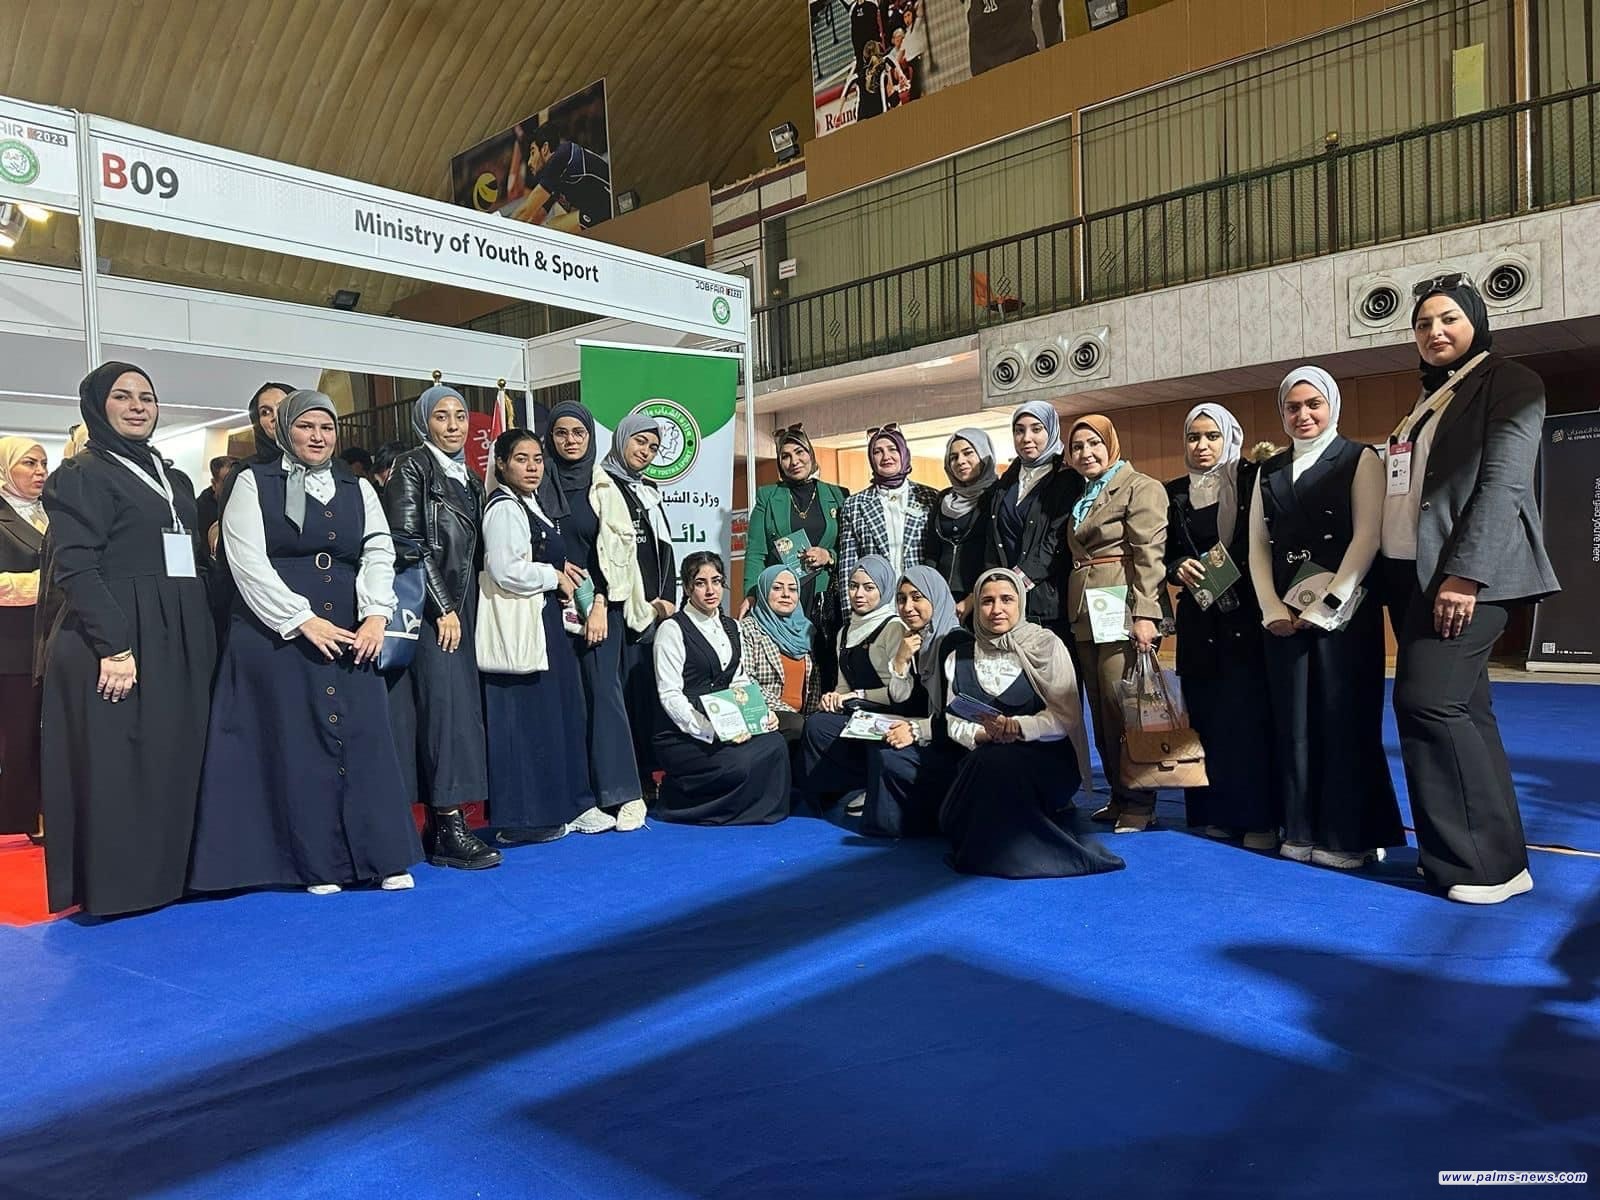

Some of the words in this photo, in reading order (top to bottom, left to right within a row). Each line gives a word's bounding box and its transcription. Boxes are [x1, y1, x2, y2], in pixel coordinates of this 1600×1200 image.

[36, 130, 67, 146] 2023
[102, 152, 179, 199] B09
[354, 208, 444, 254] Ministry
[449, 233, 471, 255] of
[474, 235, 530, 268] Youth
[534, 249, 548, 272] &
[552, 254, 600, 284] Sport
[661, 490, 690, 507] الشبا
[692, 491, 720, 508] وزارة
[671, 523, 706, 543] دائ
